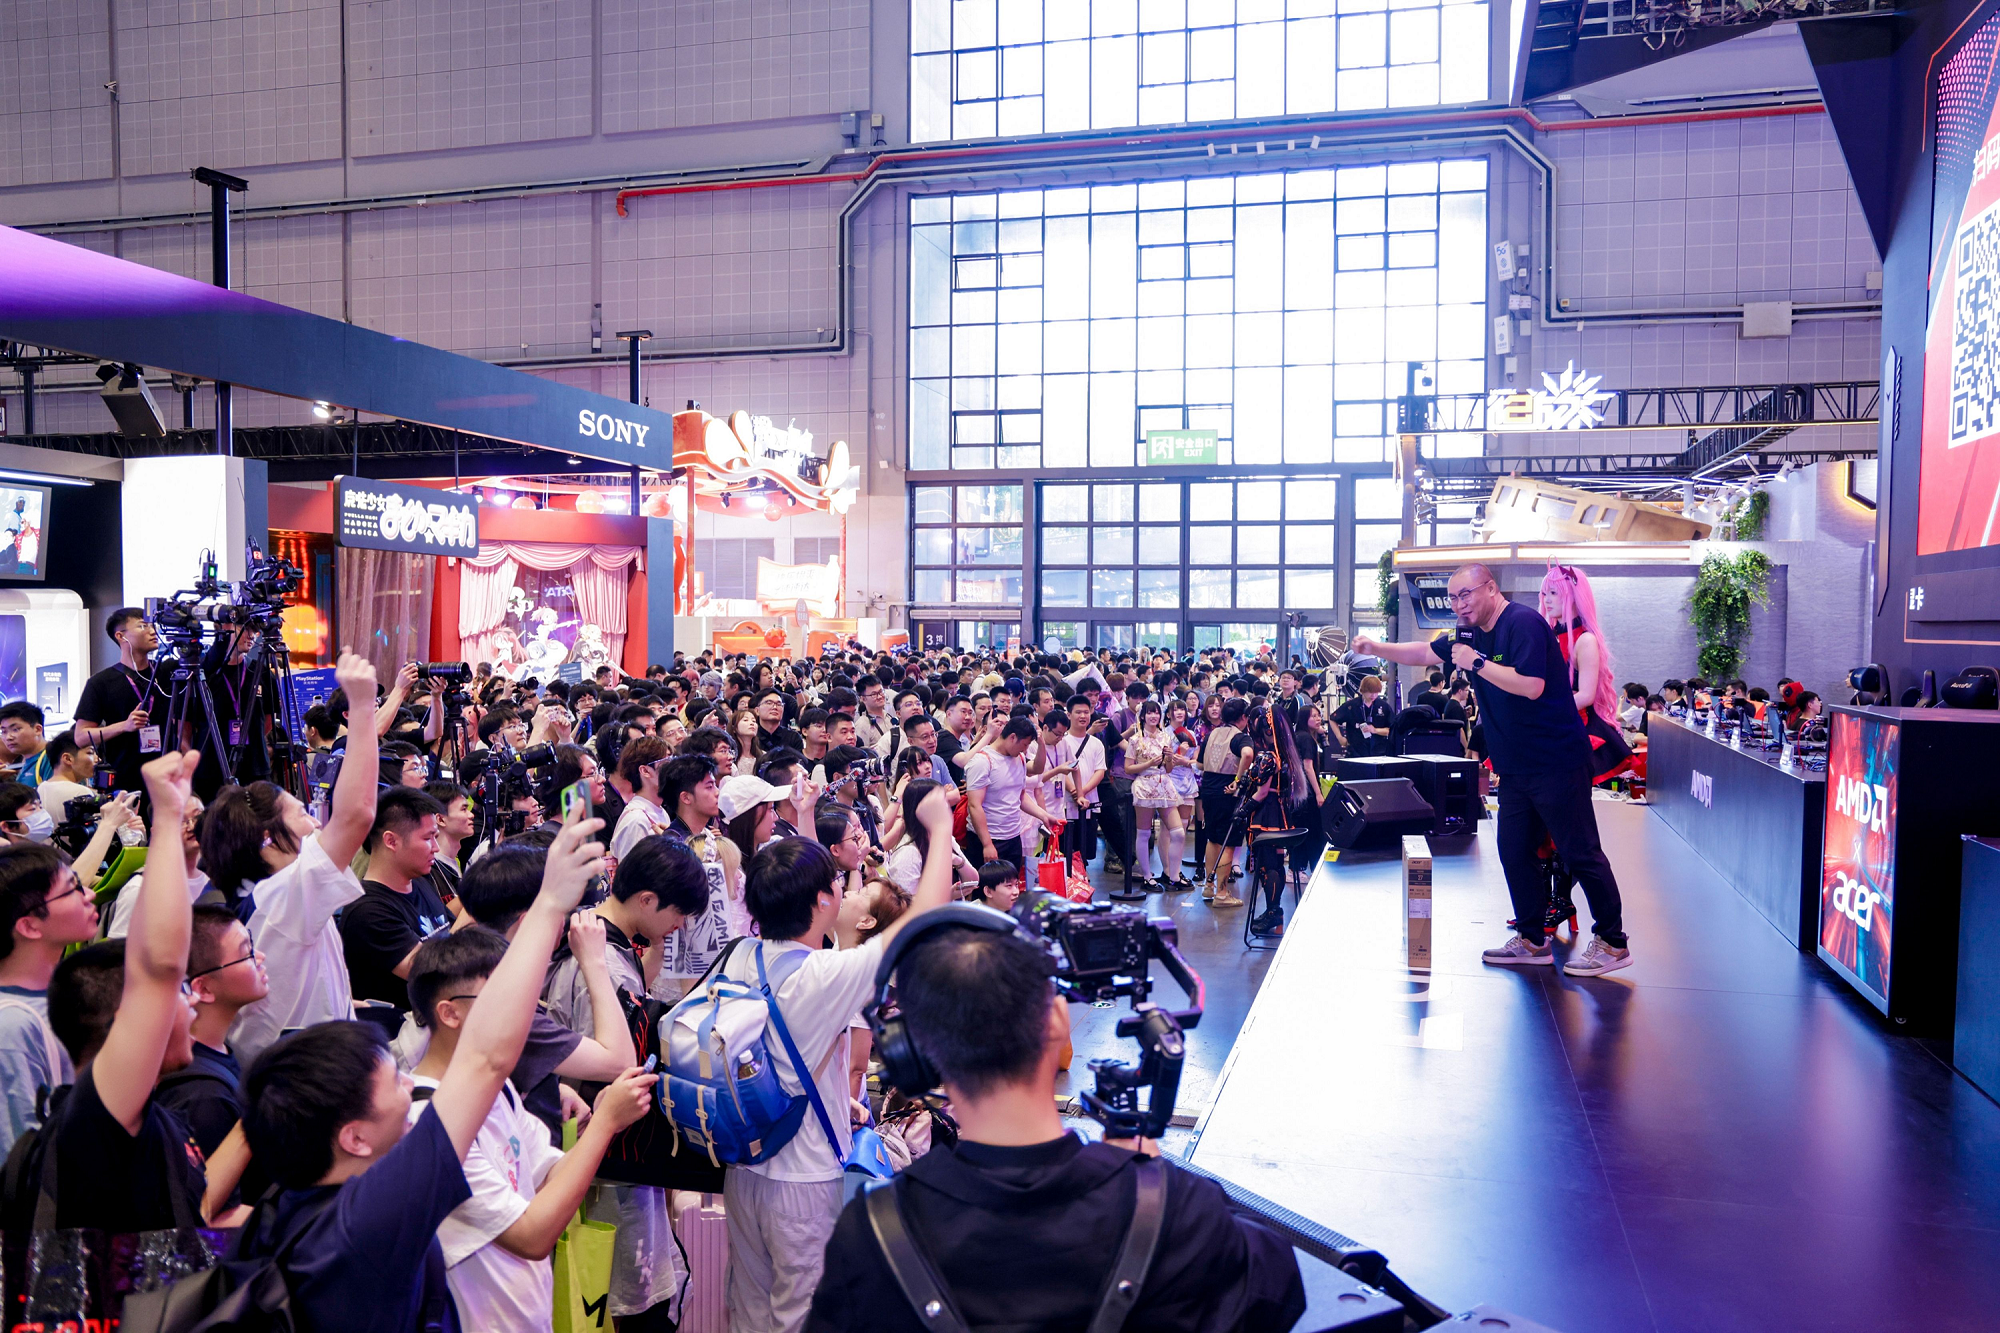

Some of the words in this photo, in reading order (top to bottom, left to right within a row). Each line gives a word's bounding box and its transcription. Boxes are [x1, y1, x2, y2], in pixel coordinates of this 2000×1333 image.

[579, 409, 650, 448] SONY
[1175, 437, 1213, 449] 安全出口
[1184, 449, 1204, 457] EXIT
[343, 519, 379, 529] MADOKA
[343, 527, 379, 538] MAGICA
[295, 675, 325, 683] PlayStation
[1690, 769, 1707, 805] AMD
[1835, 774, 1873, 824] AMD
[1833, 870, 1881, 932] acer
